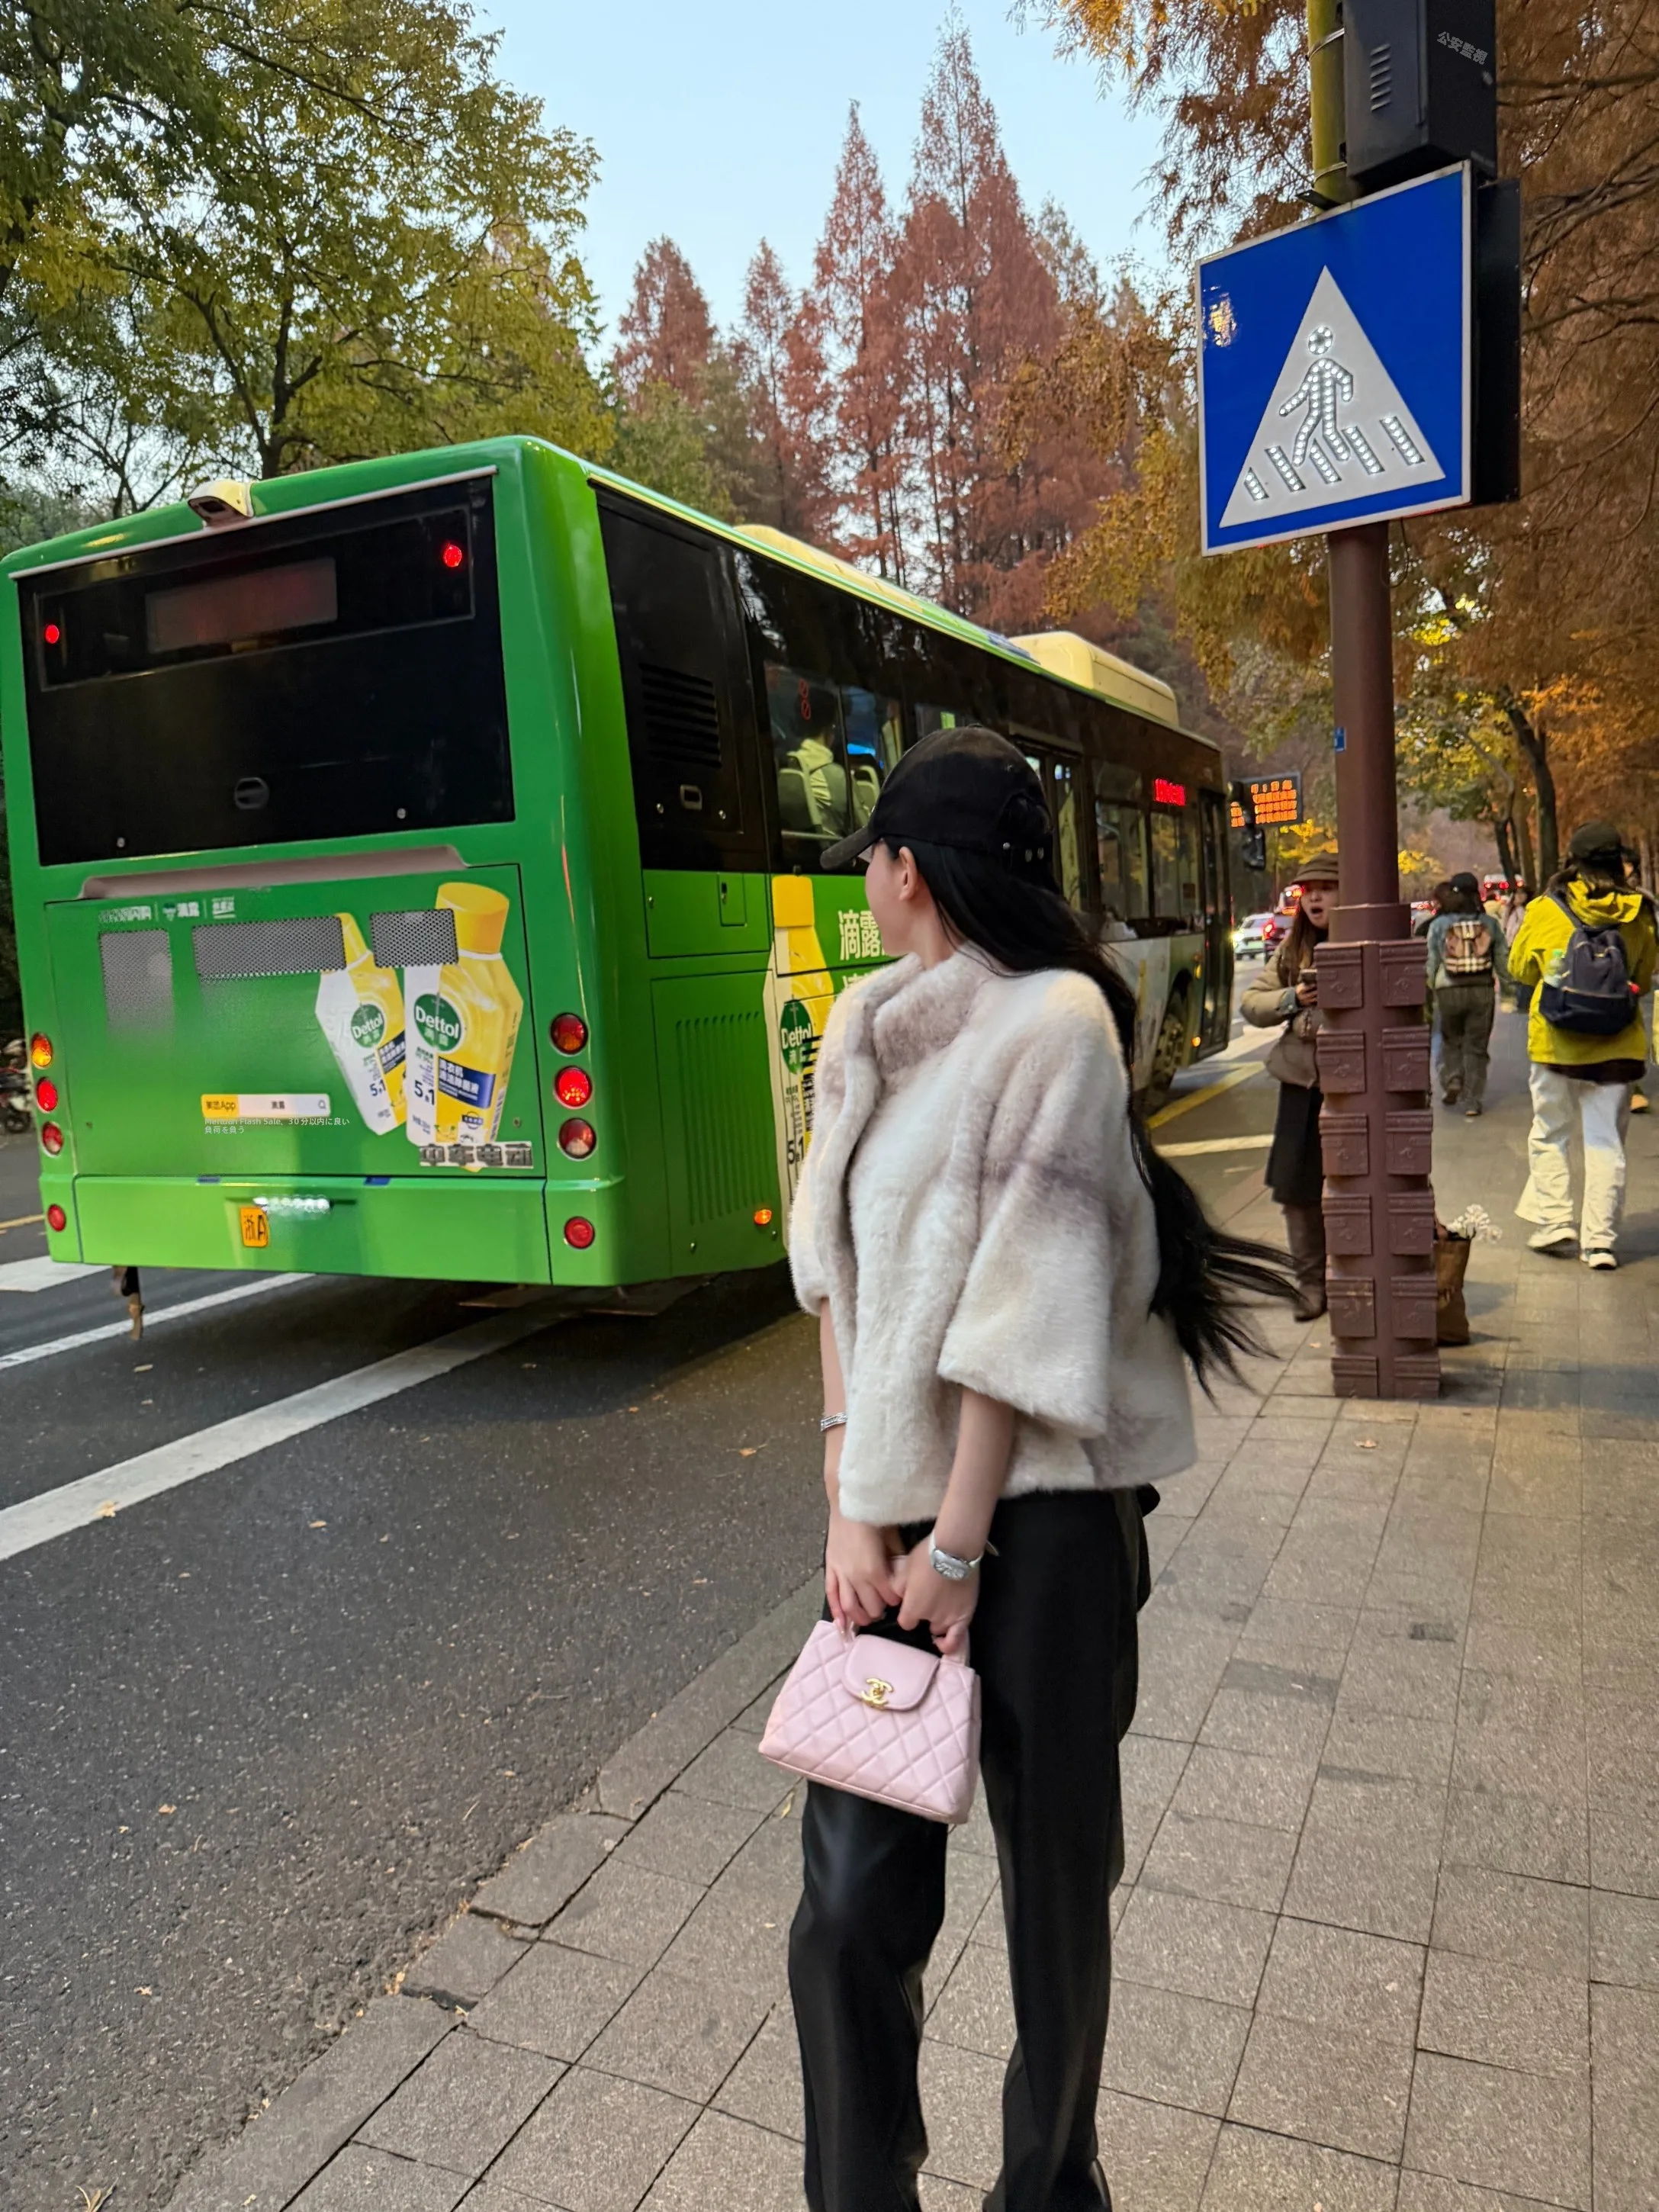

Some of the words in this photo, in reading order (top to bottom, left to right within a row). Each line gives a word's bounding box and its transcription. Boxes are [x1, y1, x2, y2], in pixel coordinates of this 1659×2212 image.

[838, 908, 886, 961] 滴露
[352, 1014, 384, 1039] Dettol
[415, 1005, 459, 1039] Dettol
